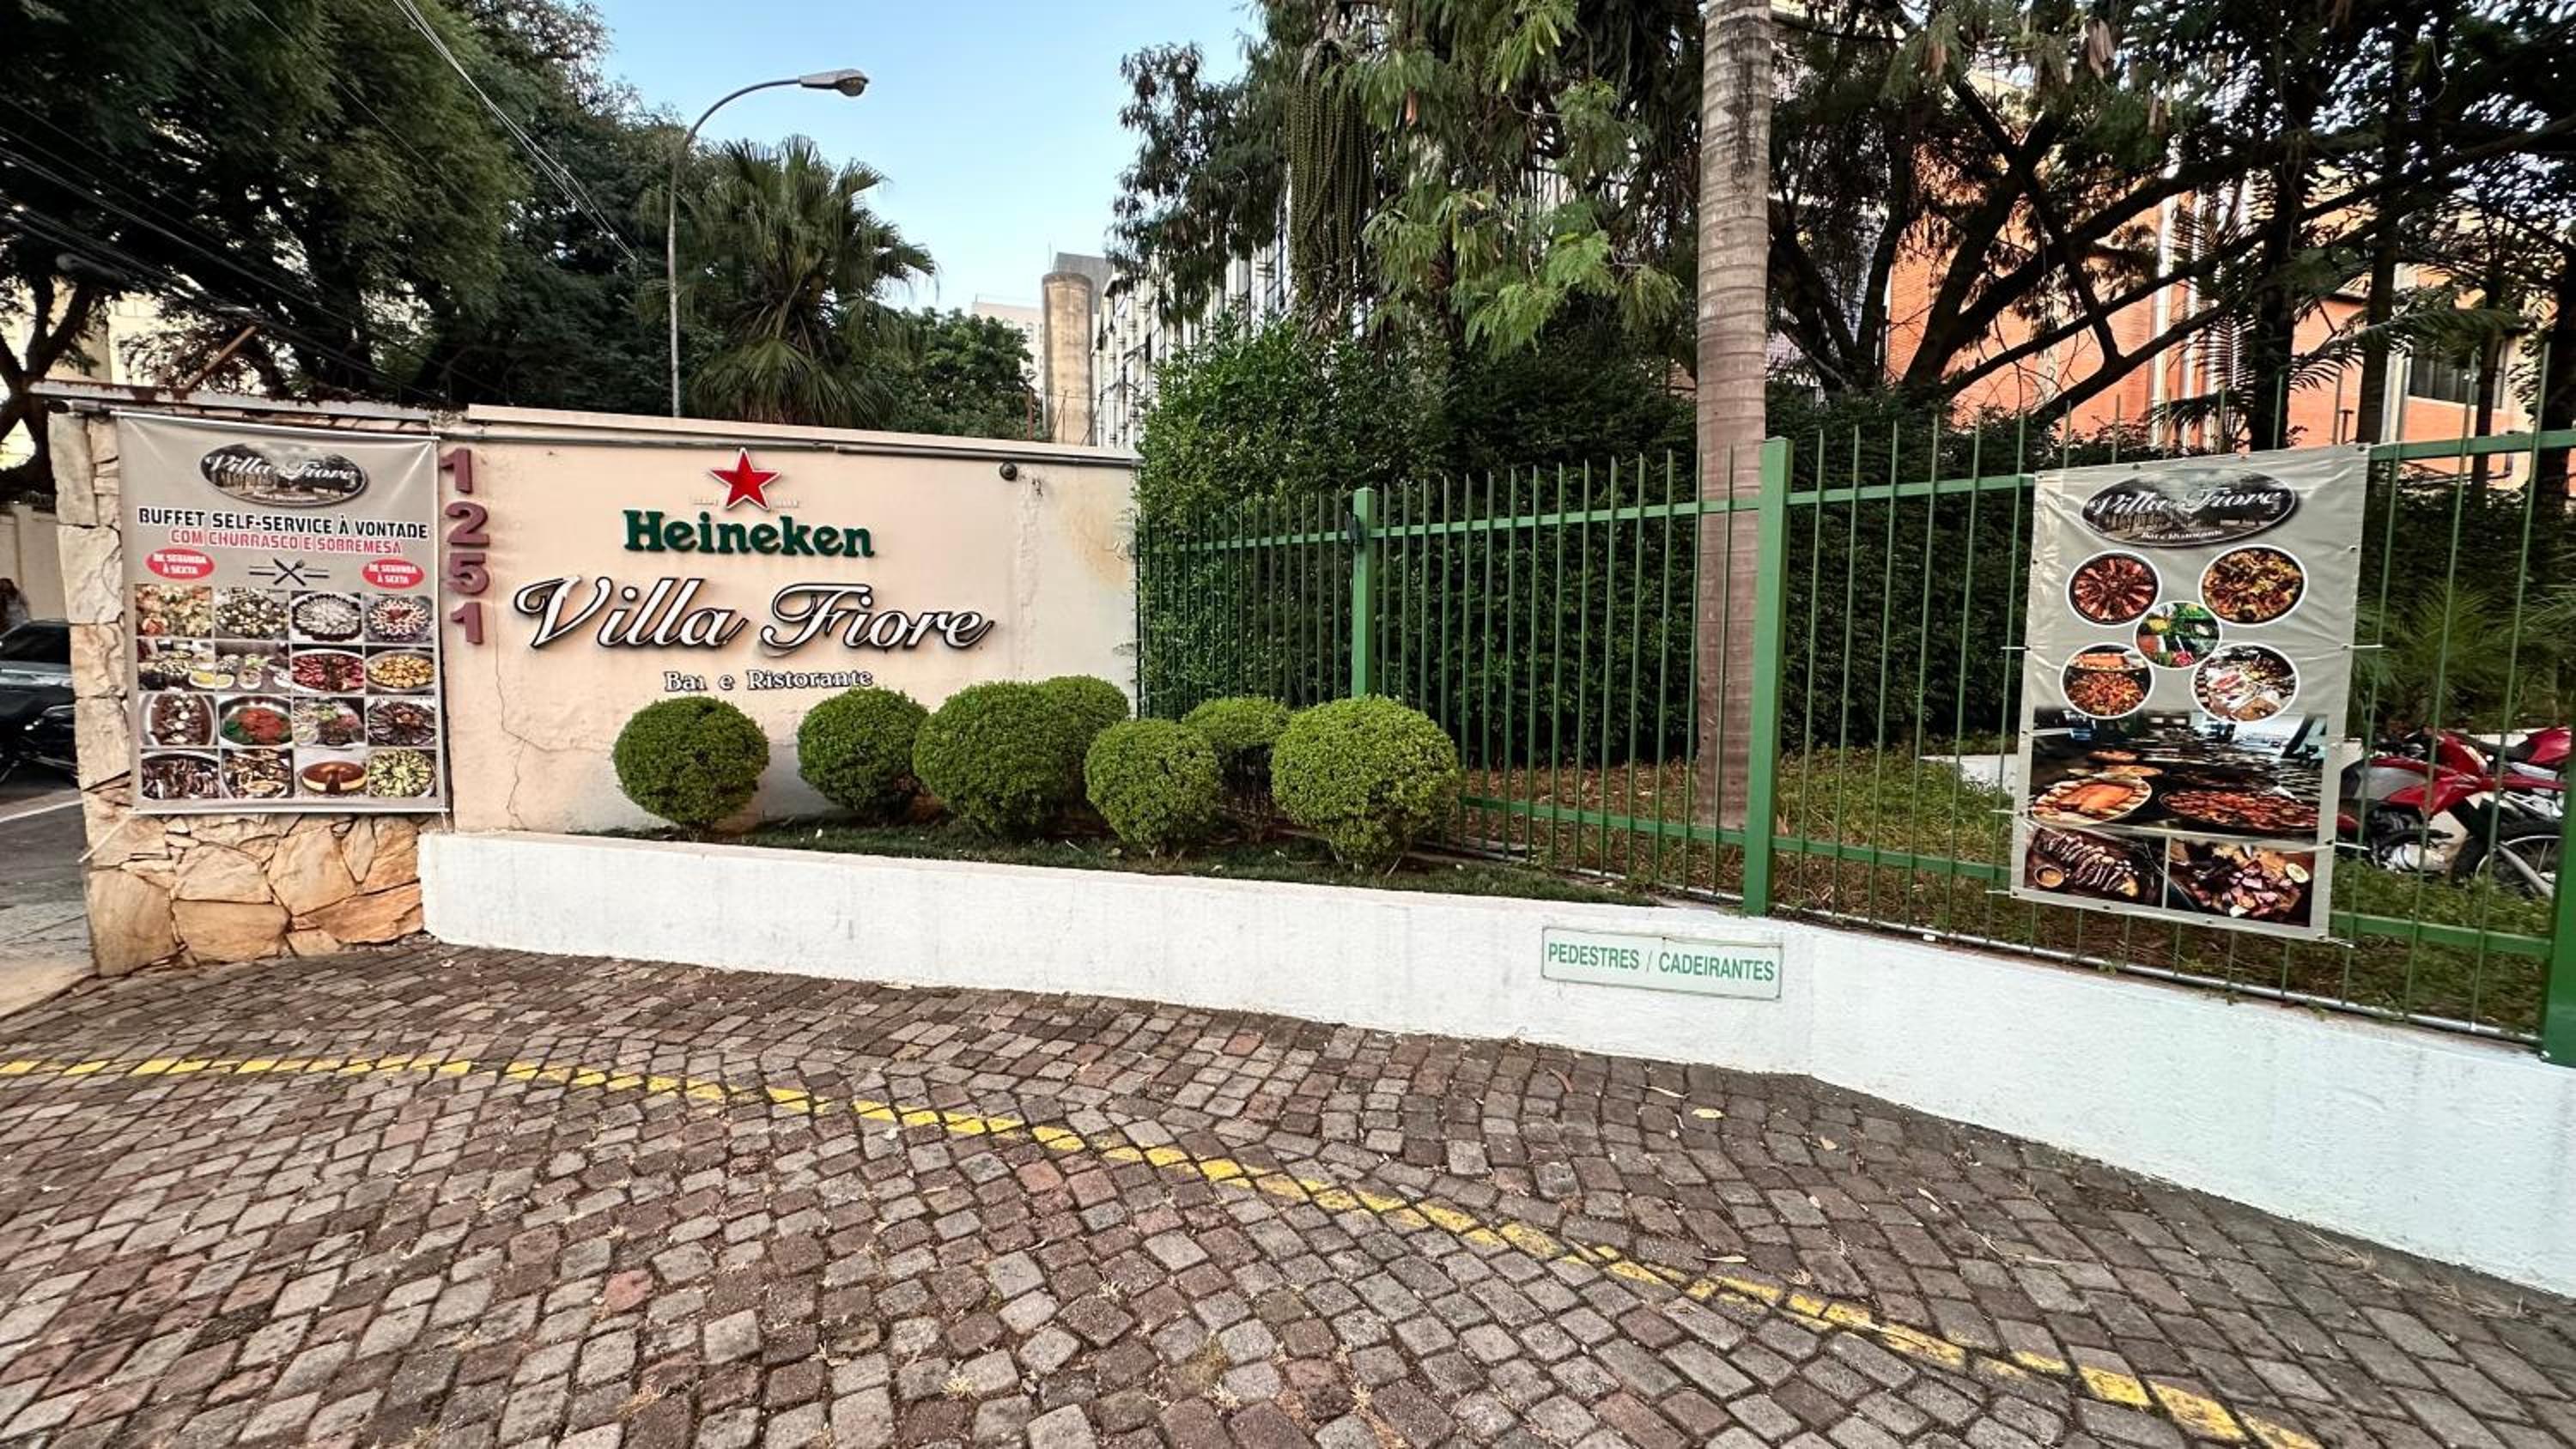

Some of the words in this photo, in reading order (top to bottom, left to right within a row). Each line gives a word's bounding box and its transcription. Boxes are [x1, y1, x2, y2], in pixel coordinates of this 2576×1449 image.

[138, 507, 205, 526] BUFFET
[213, 512, 331, 534] SELF-SERVICE
[338, 515, 349, 535] À
[355, 521, 428, 539] VONTADE
[623, 509, 874, 558] Heineken
[171, 530, 204, 545] COM
[209, 530, 298, 549] CHURRASCO
[303, 537, 311, 550] E
[316, 537, 402, 554] SOBREMESA
[513, 575, 748, 651] Villa
[759, 581, 993, 657] Fiore
[718, 674, 735, 690] e
[746, 670, 874, 690] Ristorante
[1549, 943, 1639, 969] PEDESTRES
[1646, 949, 1654, 972] /
[1658, 952, 1774, 980] CADEIRANTES
